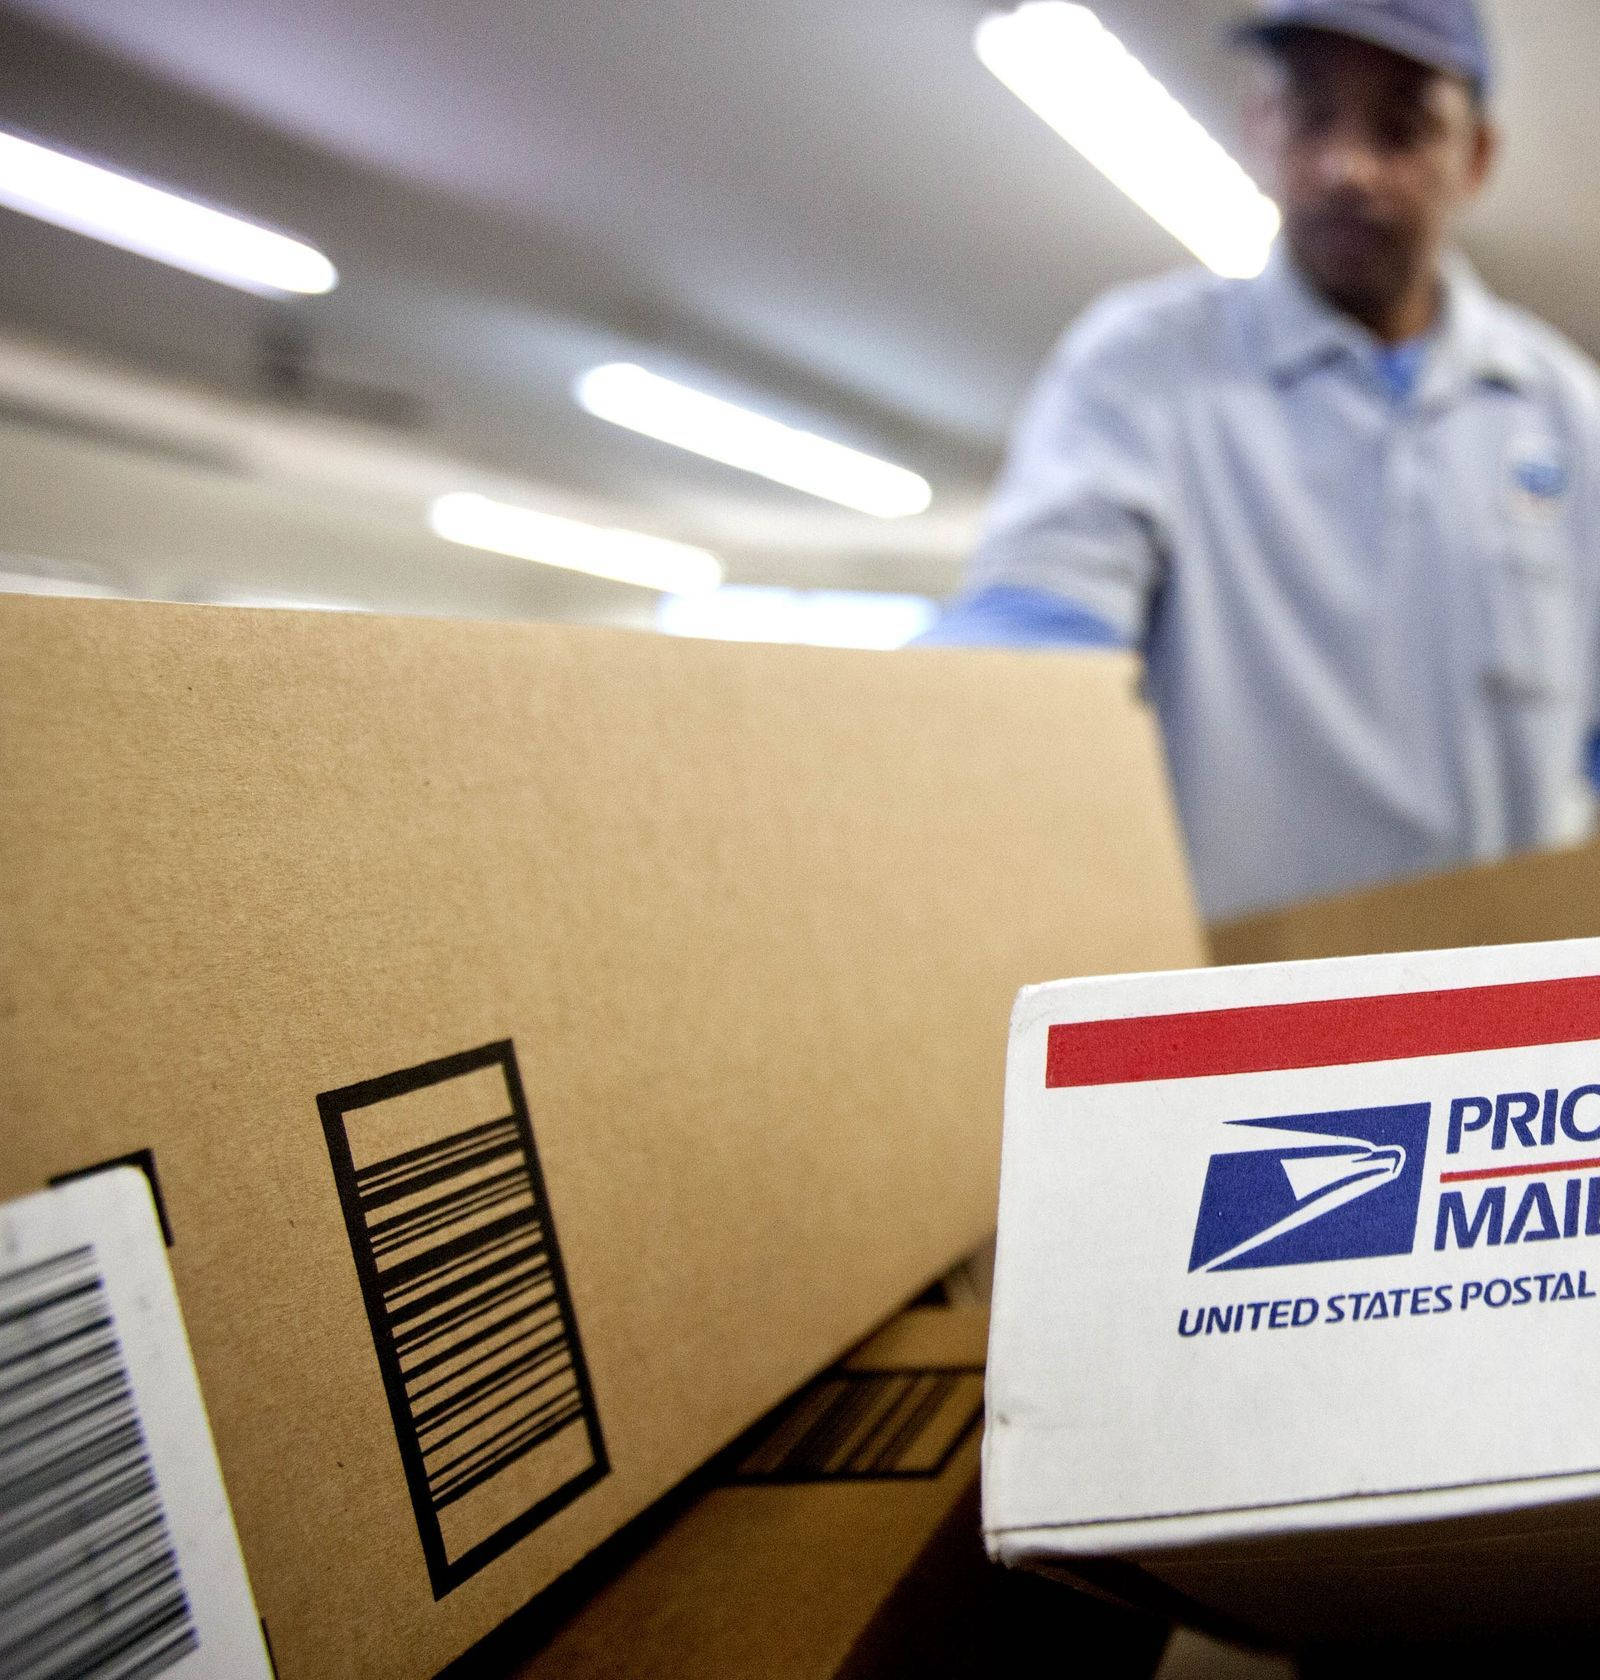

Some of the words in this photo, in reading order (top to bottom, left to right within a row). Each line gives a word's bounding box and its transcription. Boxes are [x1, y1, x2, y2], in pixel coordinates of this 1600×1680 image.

[1177, 1297, 1320, 1339] UNITED
[1324, 1284, 1453, 1324] STATES
[1459, 1270, 1597, 1311] POSTAL
